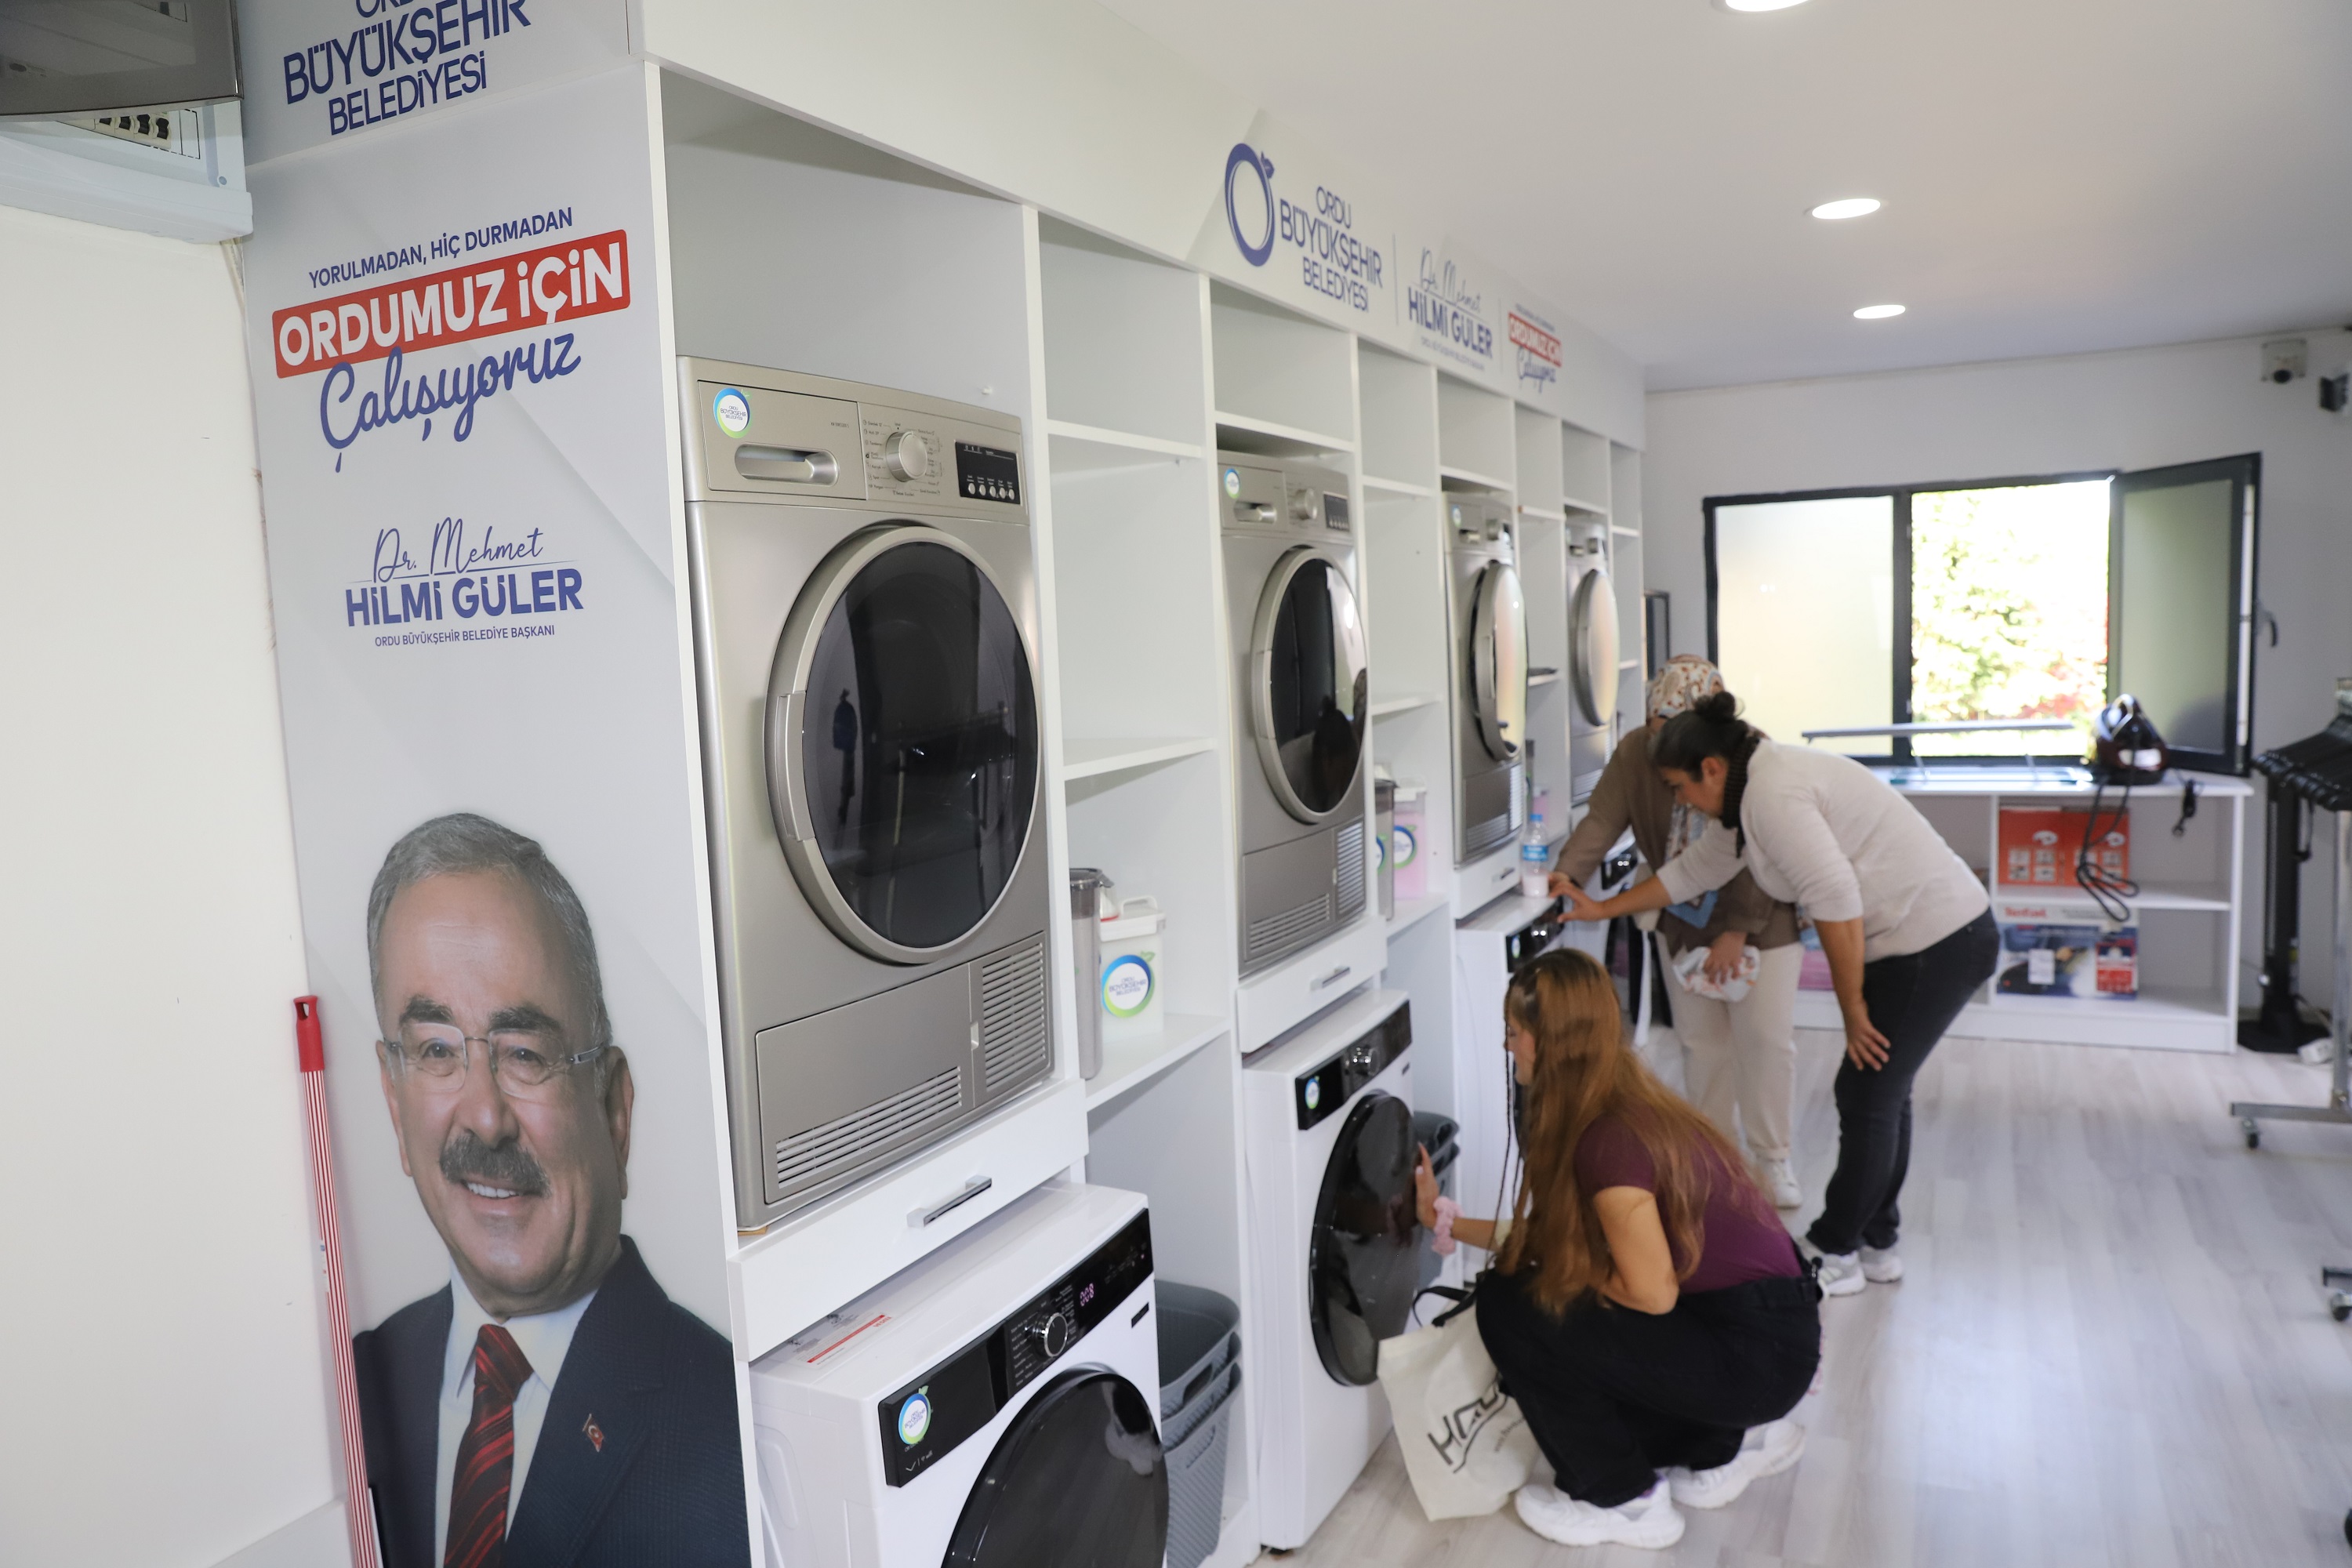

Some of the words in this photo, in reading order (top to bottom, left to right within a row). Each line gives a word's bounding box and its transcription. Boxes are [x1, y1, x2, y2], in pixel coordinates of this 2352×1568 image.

[328, 50, 487, 136] BELEDİYESİ
[1316, 186, 1352, 230] ORDU
[309, 244, 427, 289] YORULMADAN,
[431, 232, 461, 260] HİÇ
[465, 207, 573, 252] DURMADAN
[279, 268, 508, 366] ORDUMUZ
[517, 241, 624, 325] İÇİN
[320, 333, 582, 473] Çalışıyoruz
[373, 528, 417, 583] Dr.
[430, 517, 543, 575] Mehmet
[345, 580, 443, 626] HİLMİ
[452, 568, 584, 619] GÜLER
[375, 634, 401, 648] ORDU
[402, 629, 460, 645] BÜYÜKŞEHİR
[463, 626, 509, 641] BELEDİYE
[511, 624, 555, 639] BAŞKANI
